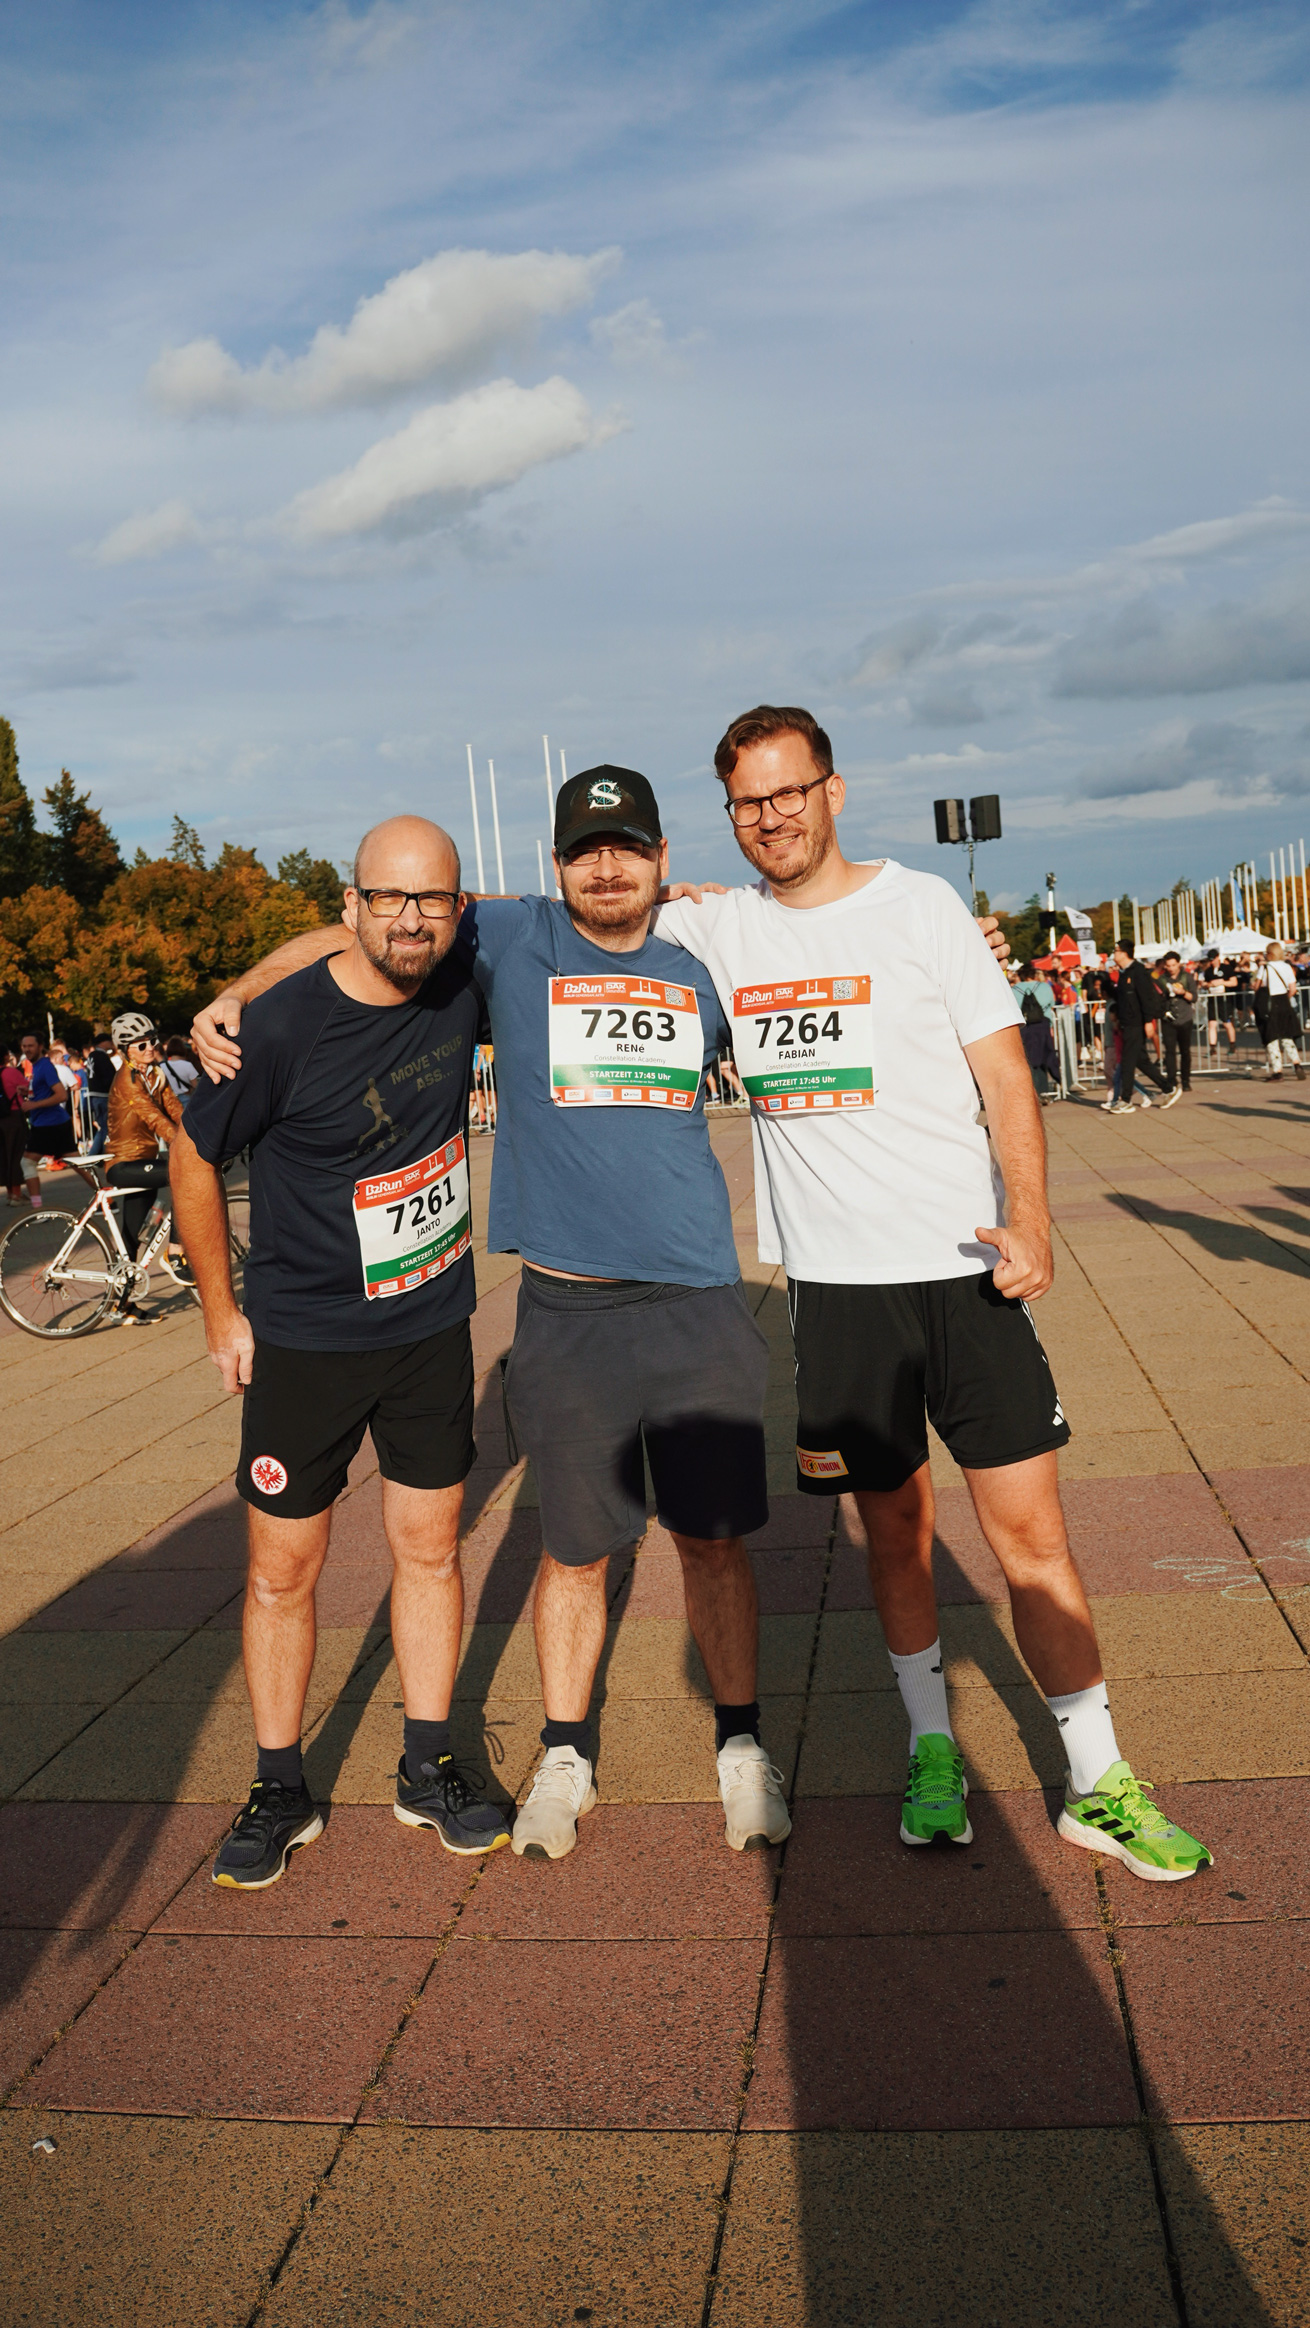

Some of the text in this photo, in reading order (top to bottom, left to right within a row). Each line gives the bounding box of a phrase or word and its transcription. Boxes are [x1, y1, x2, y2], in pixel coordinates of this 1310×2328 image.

[589, 782, 622, 809] S
[564, 982, 602, 994] B2Run
[742, 991, 772, 1004] B2Run
[581, 1009, 676, 1042] 7263
[755, 1011, 843, 1049] 7264
[594, 1054, 666, 1065] Constellation Academy
[778, 1048, 816, 1060] FABIAN
[390, 1054, 431, 1085] MOVE
[765, 1060, 831, 1071] Constellation Academy
[589, 1070, 671, 1081] STARTZEIT 17:45 Uhr
[763, 1078, 798, 1089] STARTZEIT
[799, 1076, 820, 1085] 17:45
[821, 1076, 837, 1084] Uhr
[366, 1180, 402, 1196] B2Run
[386, 1176, 456, 1235] 7261
[150, 1218, 172, 1254] FOC
[402, 1221, 452, 1252] Constellation Academy
[416, 1217, 441, 1239] JANTO
[400, 1249, 433, 1269] STARTZEIT
[434, 1240, 448, 1253] 17:45
[447, 1232, 456, 1242] Uhr
[817, 1461, 841, 1472] UNION
